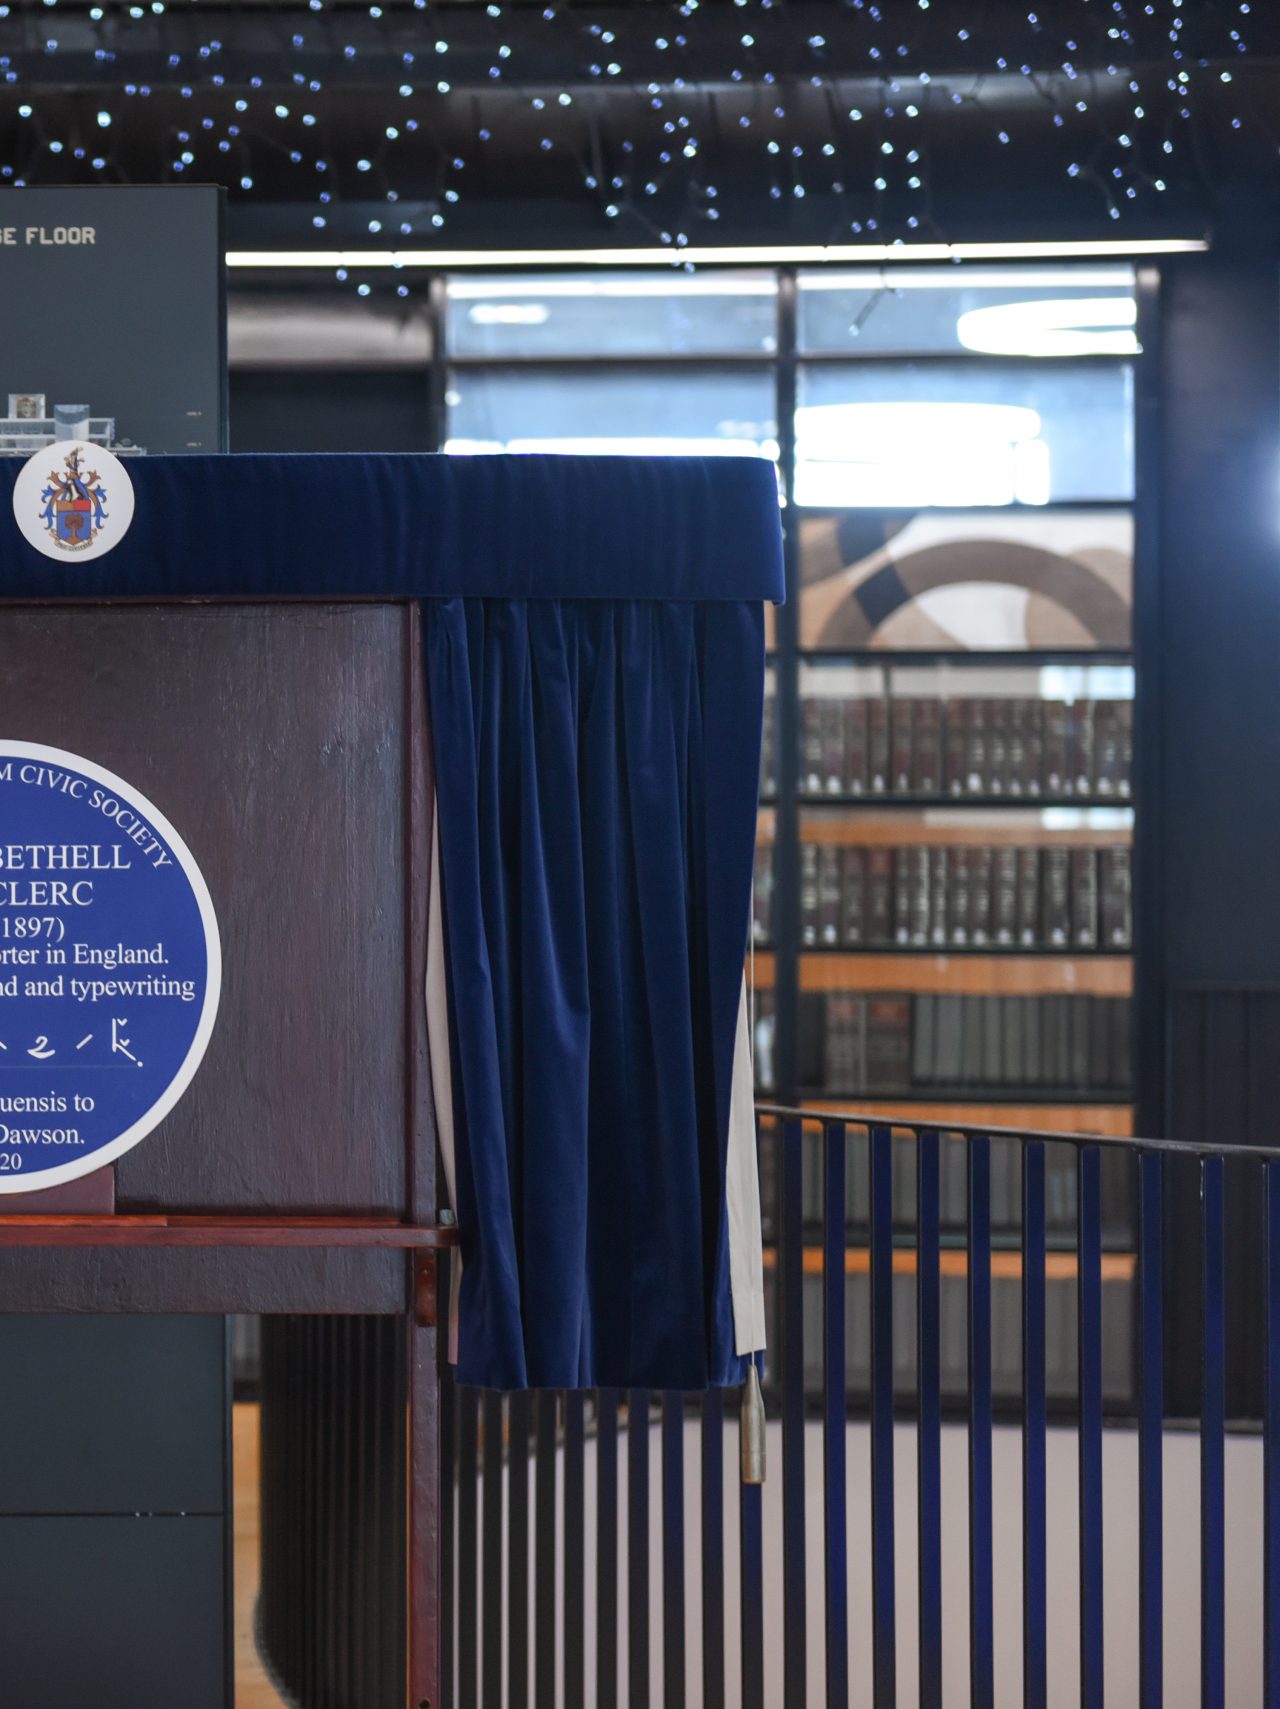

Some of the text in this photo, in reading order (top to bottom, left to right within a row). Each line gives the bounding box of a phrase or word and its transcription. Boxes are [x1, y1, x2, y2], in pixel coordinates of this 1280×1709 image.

[25, 226, 96, 245] FLOOR
[20, 764, 87, 799] CIVIC
[88, 790, 172, 869] SOCIETY
[46, 943, 67, 965] in
[73, 942, 169, 970] England.
[24, 974, 64, 997] and
[70, 974, 196, 1002] typewriting
[73, 1094, 95, 1112] to
